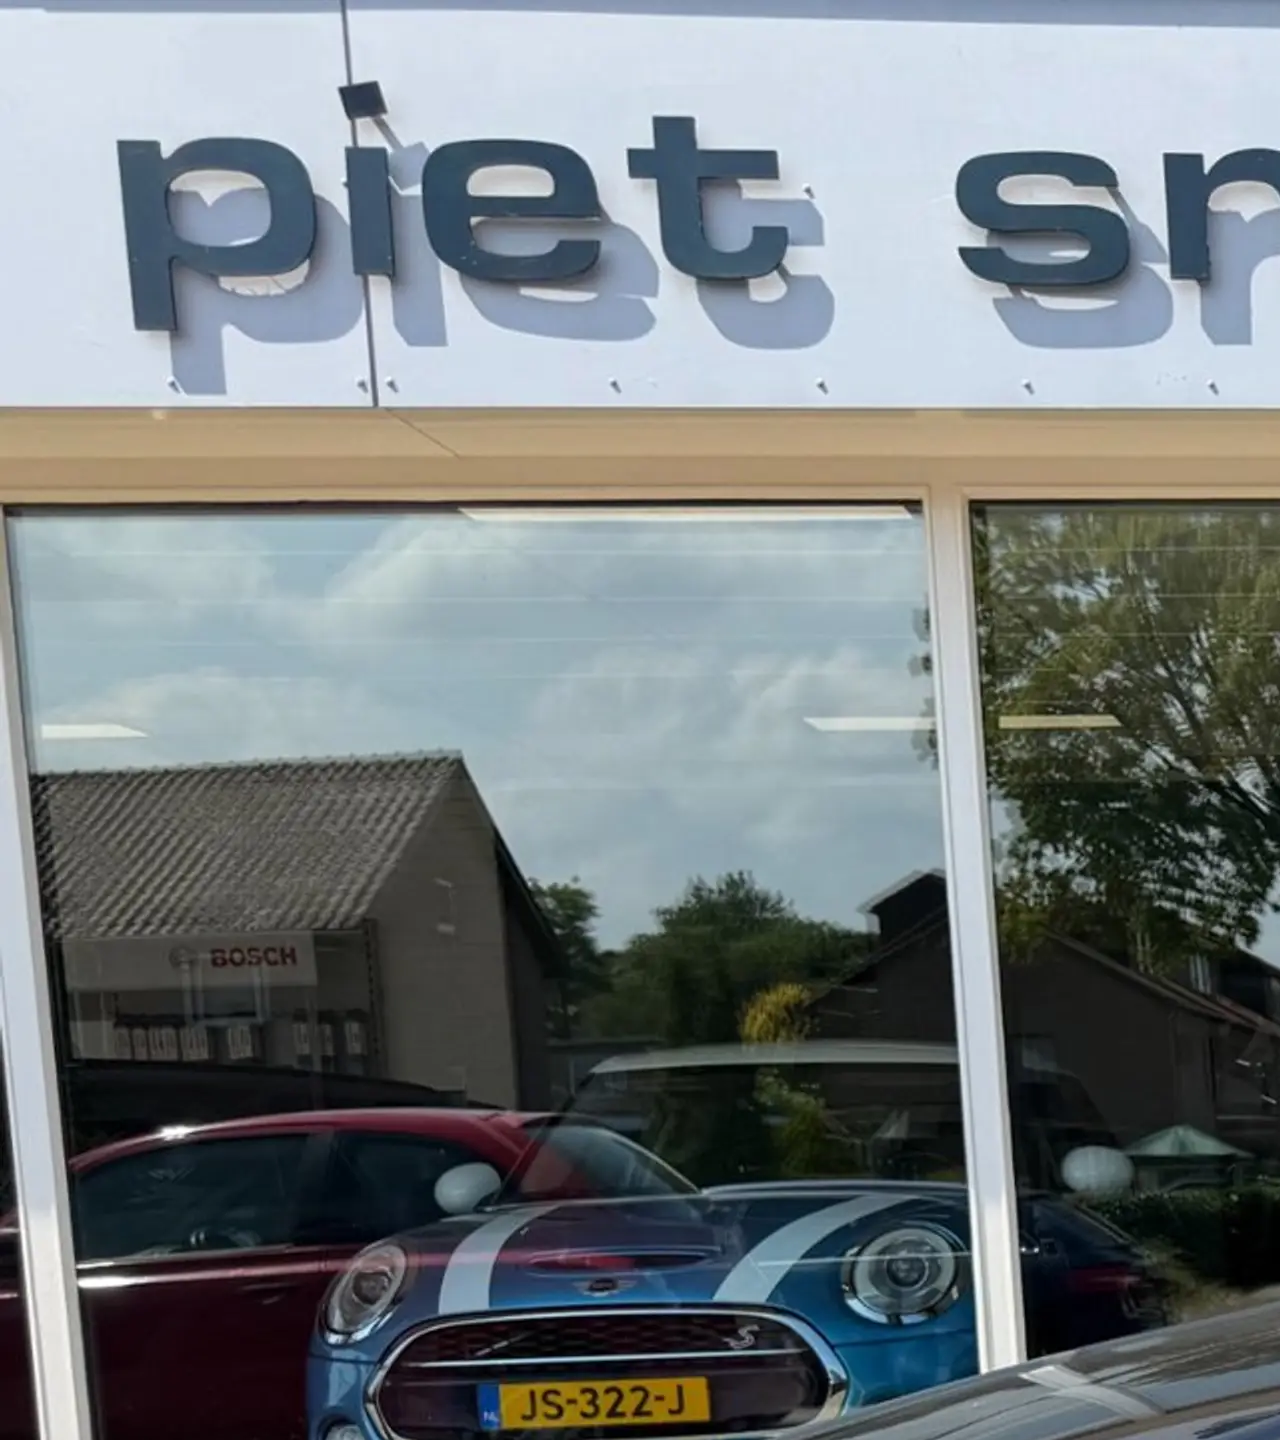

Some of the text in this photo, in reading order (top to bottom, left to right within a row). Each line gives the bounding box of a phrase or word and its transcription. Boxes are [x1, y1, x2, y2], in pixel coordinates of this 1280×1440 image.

[117, 80, 790, 332] piet
[211, 946, 298, 967] BOSCH
[521, 1384, 685, 1422] JS-322-J
